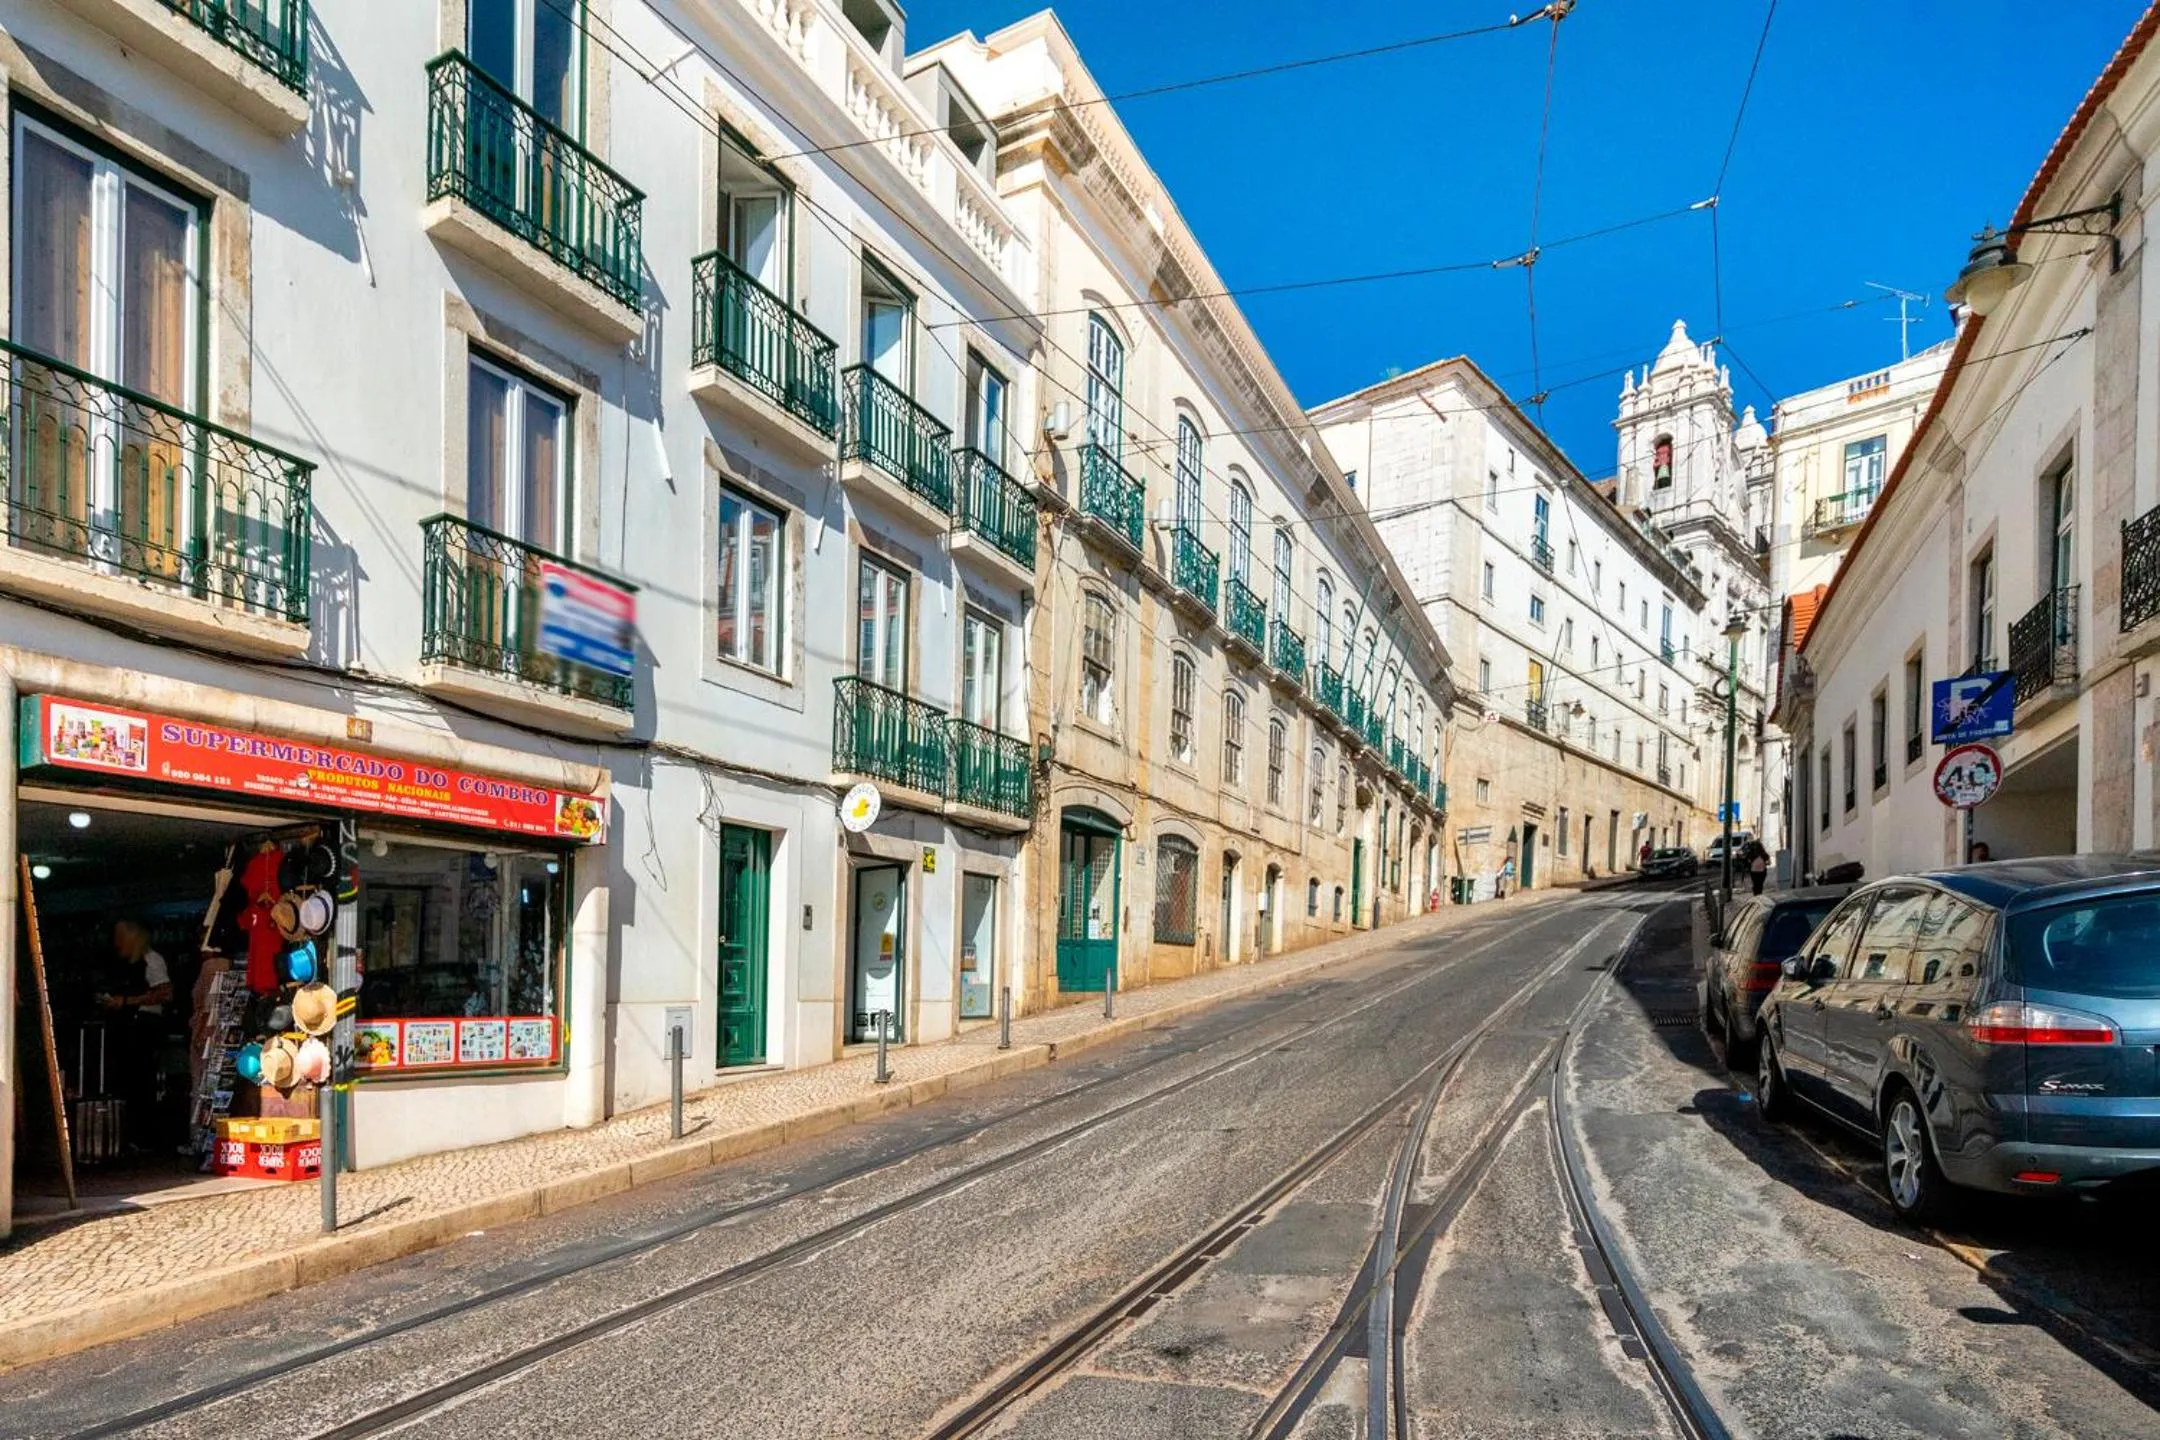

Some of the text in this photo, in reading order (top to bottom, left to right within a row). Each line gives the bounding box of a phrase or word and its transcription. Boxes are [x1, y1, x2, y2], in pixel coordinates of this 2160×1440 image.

[161, 722, 404, 782] SUPERMERCADO
[414, 767, 448, 788] DO
[459, 777, 549, 805] COMBRO
[307, 769, 452, 802] PRODUTOS NACIONAIS
[298, 1156, 320, 1166] UPER
